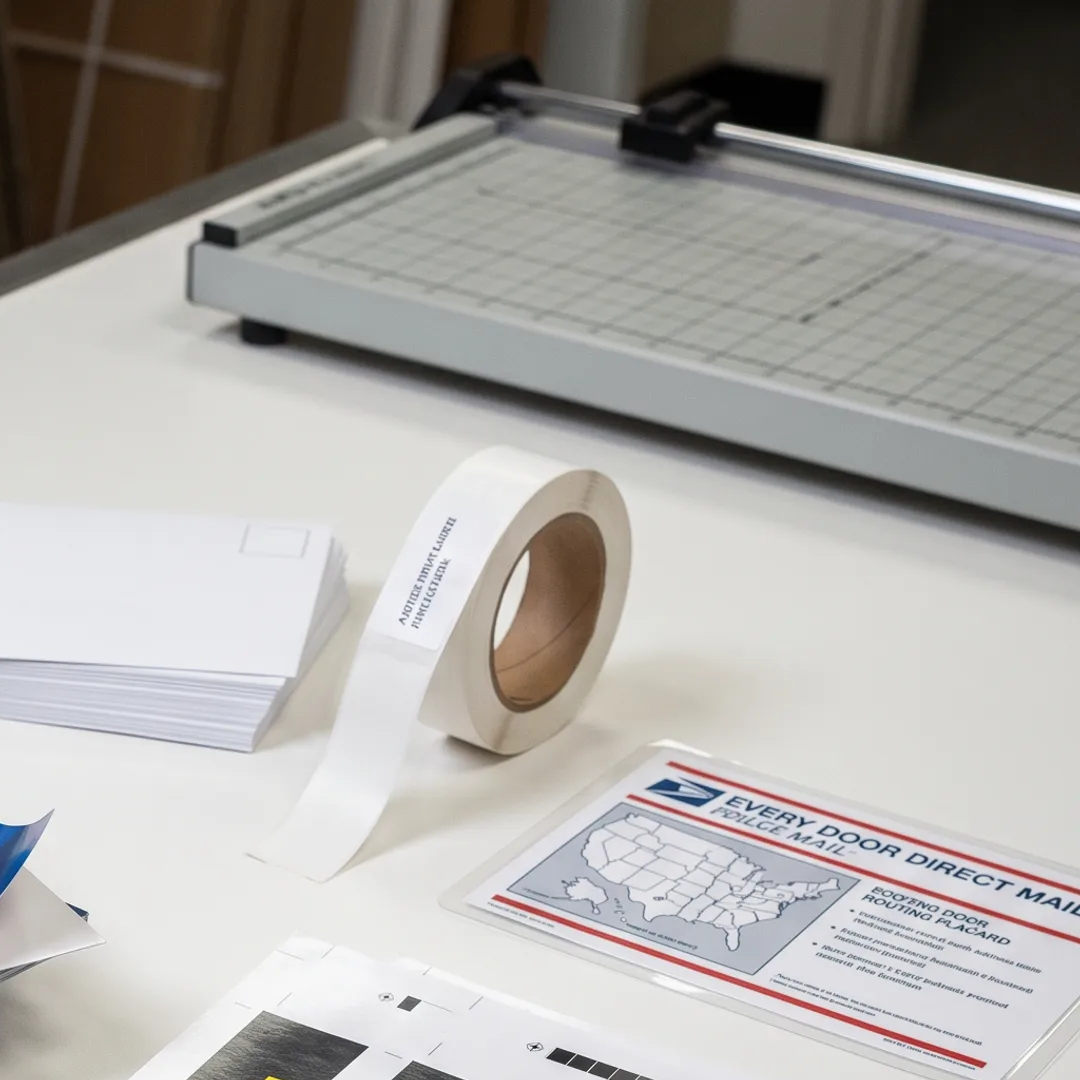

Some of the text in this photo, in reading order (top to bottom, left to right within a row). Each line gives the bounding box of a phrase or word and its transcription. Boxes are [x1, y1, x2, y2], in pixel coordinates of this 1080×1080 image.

[725, 796, 1080, 917] EVERY DOOR DIRECT MAIL
[861, 894, 932, 922] ROUTING
[941, 909, 990, 928] DOOR
